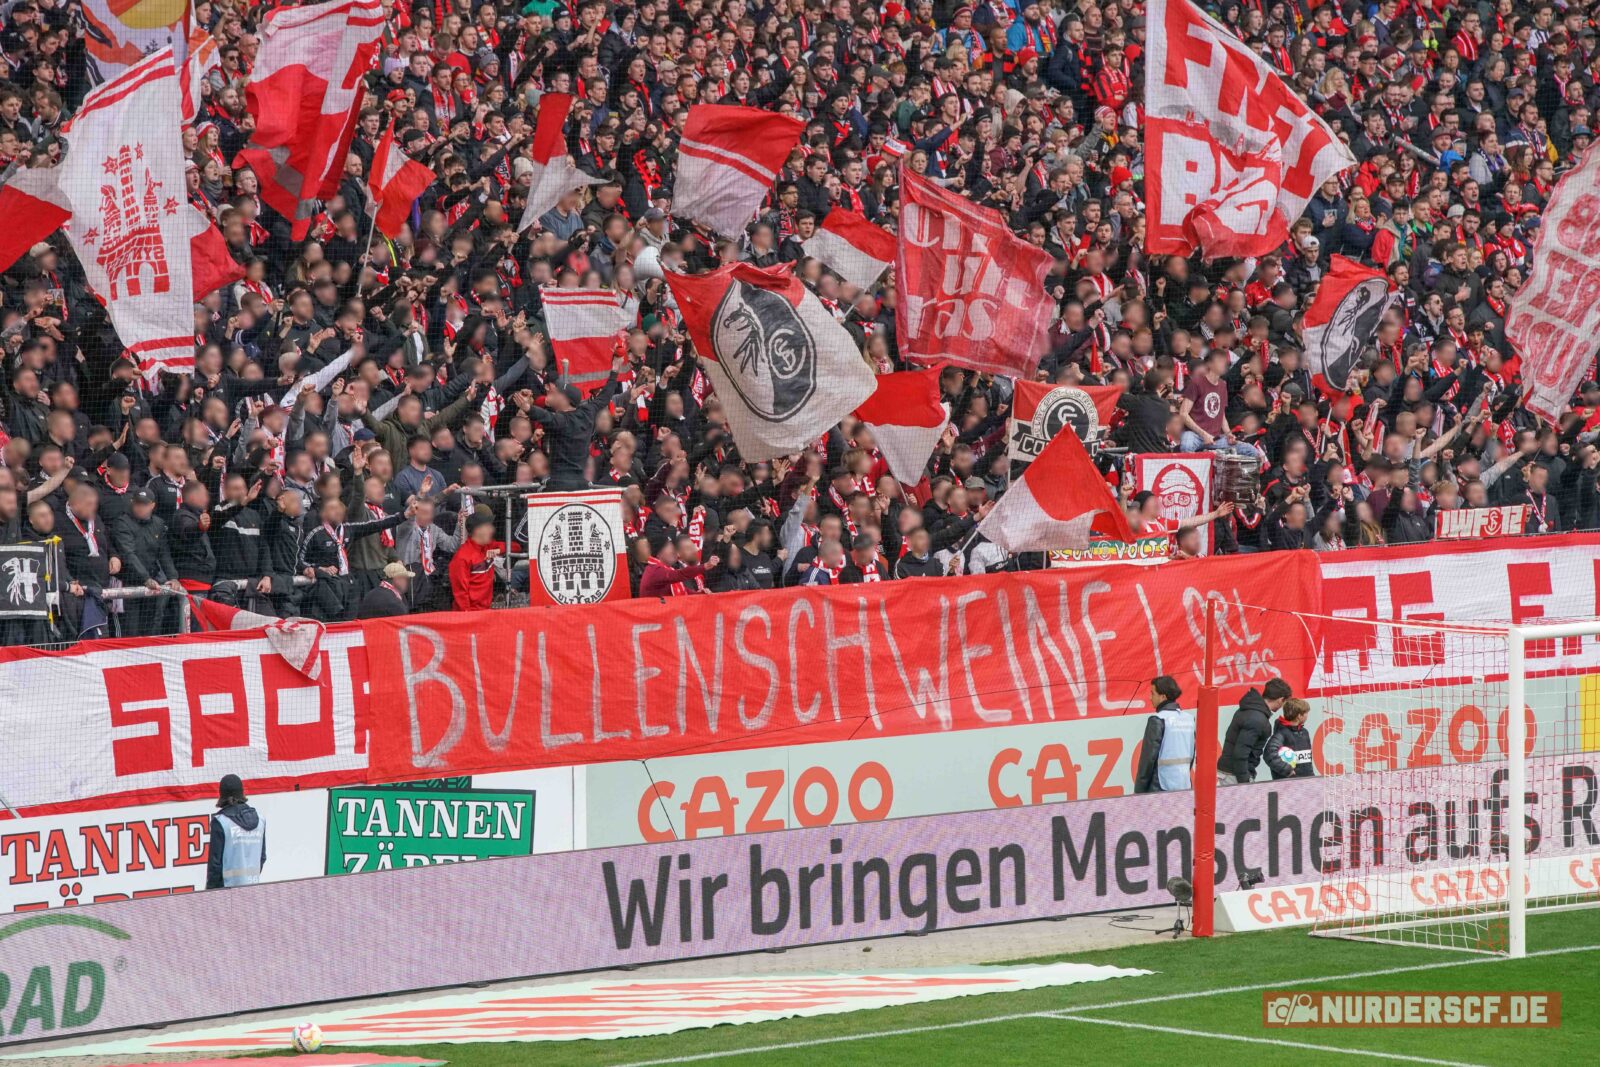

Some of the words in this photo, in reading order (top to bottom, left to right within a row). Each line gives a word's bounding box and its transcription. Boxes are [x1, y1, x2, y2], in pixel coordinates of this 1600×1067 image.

[552, 563, 604, 574] SYNTHESIA
[103, 645, 369, 776] SPO
[1312, 703, 1537, 776] CAZOO
[637, 761, 894, 842] CAZOO
[988, 733, 1221, 809] CAZ
[1, 814, 212, 885] TANNE
[337, 797, 527, 840] TANNEN
[602, 853, 728, 950] Wir
[750, 838, 1026, 931] bringen
[1247, 881, 1371, 924] CAZOO
